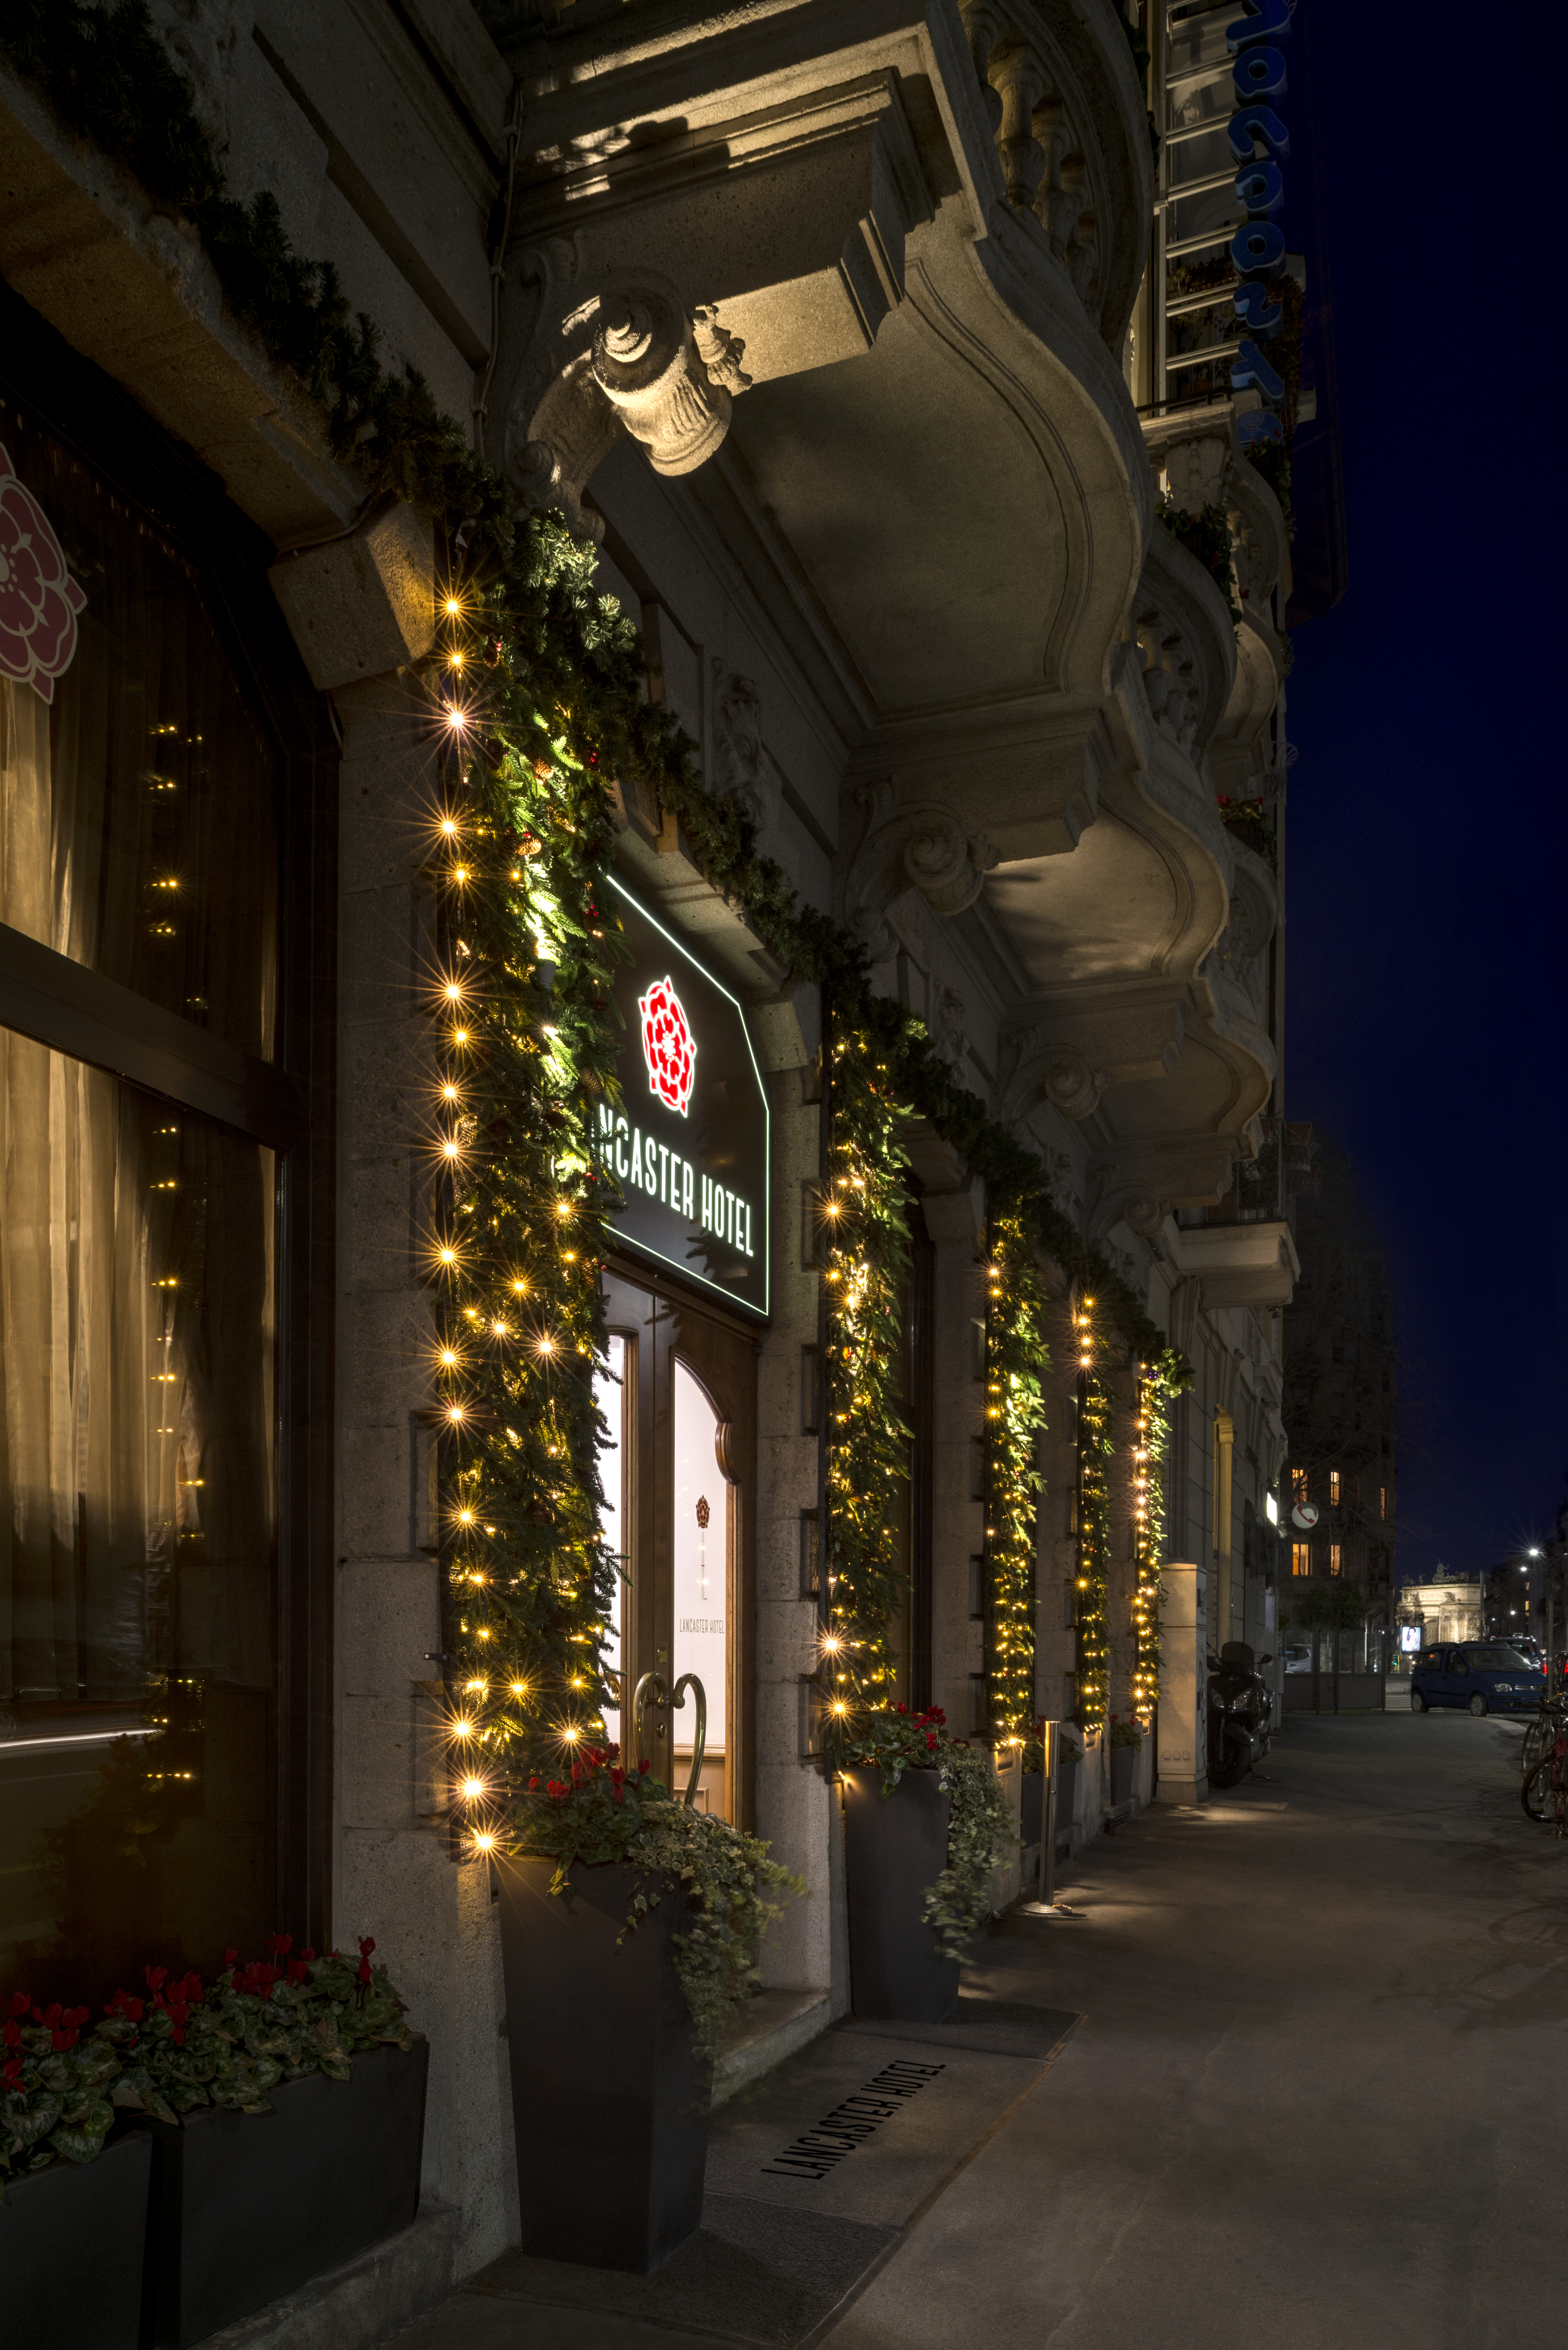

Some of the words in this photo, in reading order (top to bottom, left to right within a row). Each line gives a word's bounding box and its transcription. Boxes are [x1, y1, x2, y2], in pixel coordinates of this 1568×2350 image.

[702, 1174, 753, 1257] HOTEL
[680, 1618, 708, 1633] LANCASTER
[710, 1620, 725, 1634] HOTEL
[760, 2097, 904, 2180] LANCASTER
[860, 2060, 947, 2098] HOTEL
